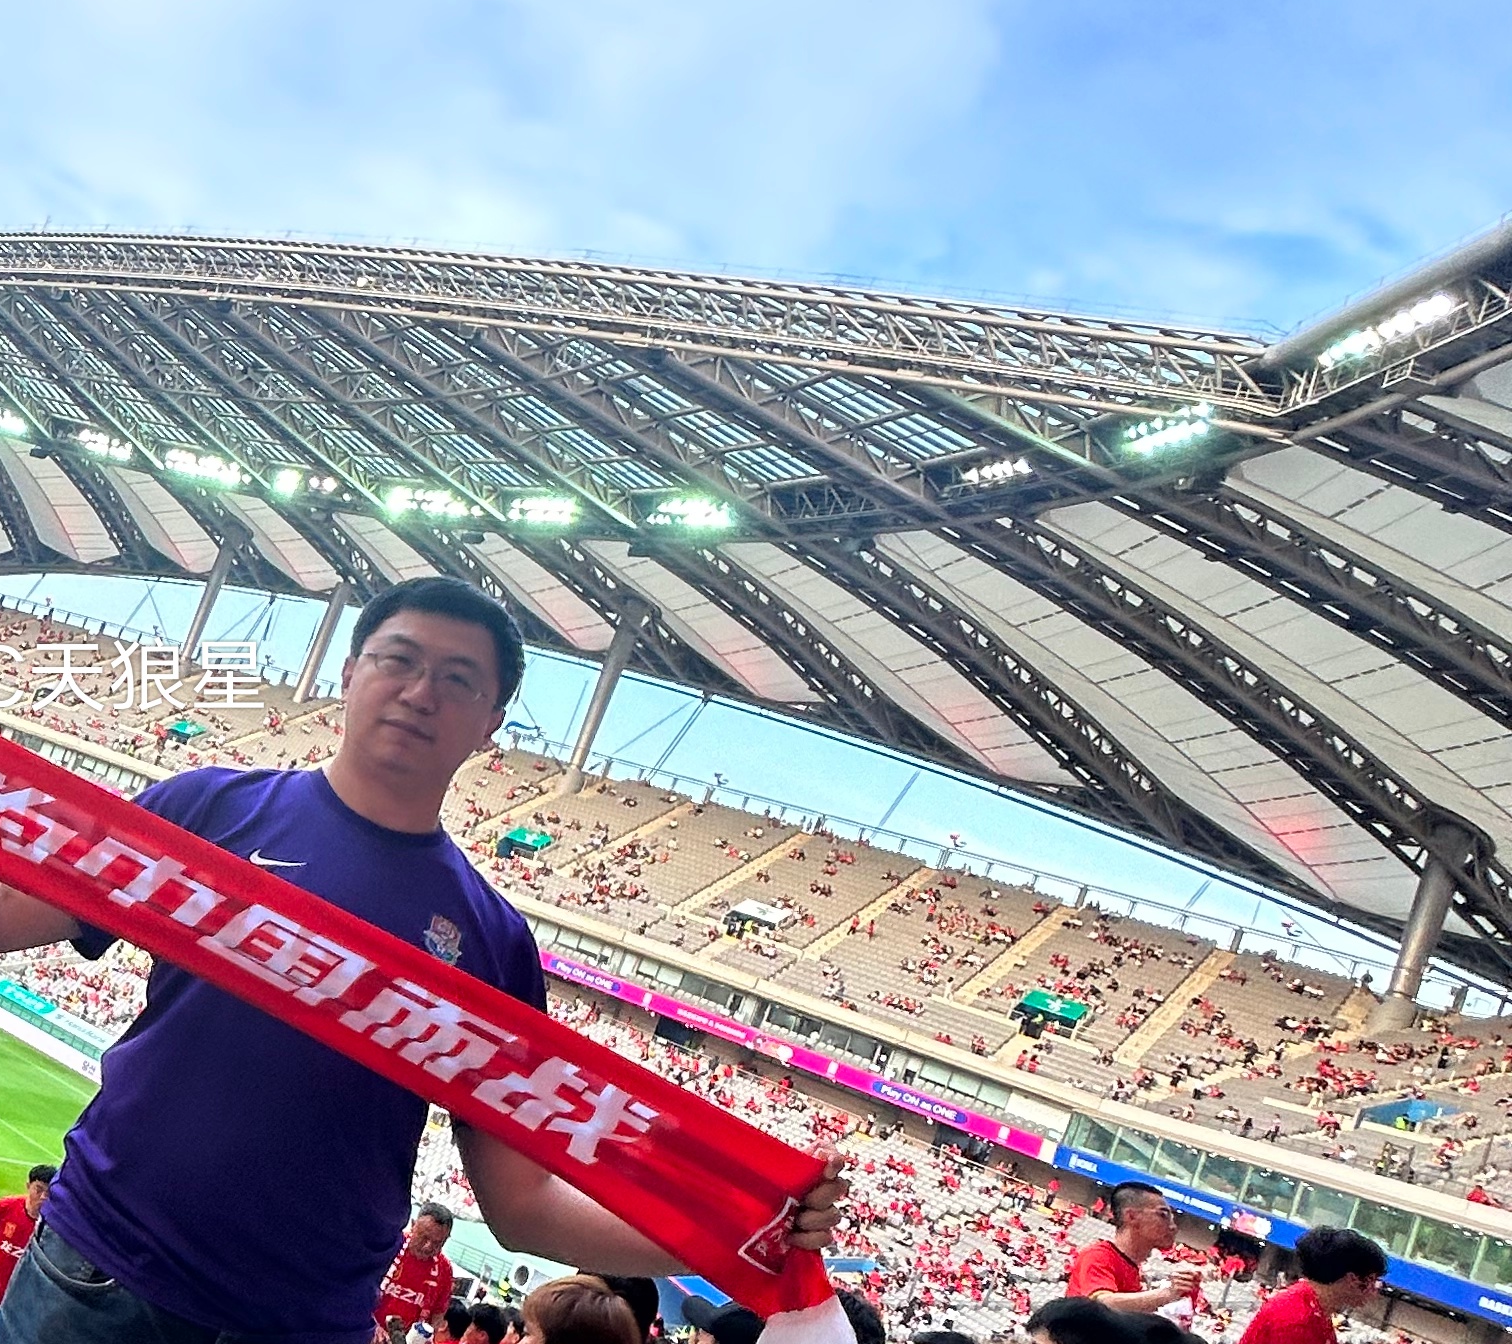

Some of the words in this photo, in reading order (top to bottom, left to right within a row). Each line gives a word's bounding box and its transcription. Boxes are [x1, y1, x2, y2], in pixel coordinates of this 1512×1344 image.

[880, 1085, 902, 1102] Play
[901, 1093, 920, 1106] ON
[932, 1104, 958, 1121] ONE
